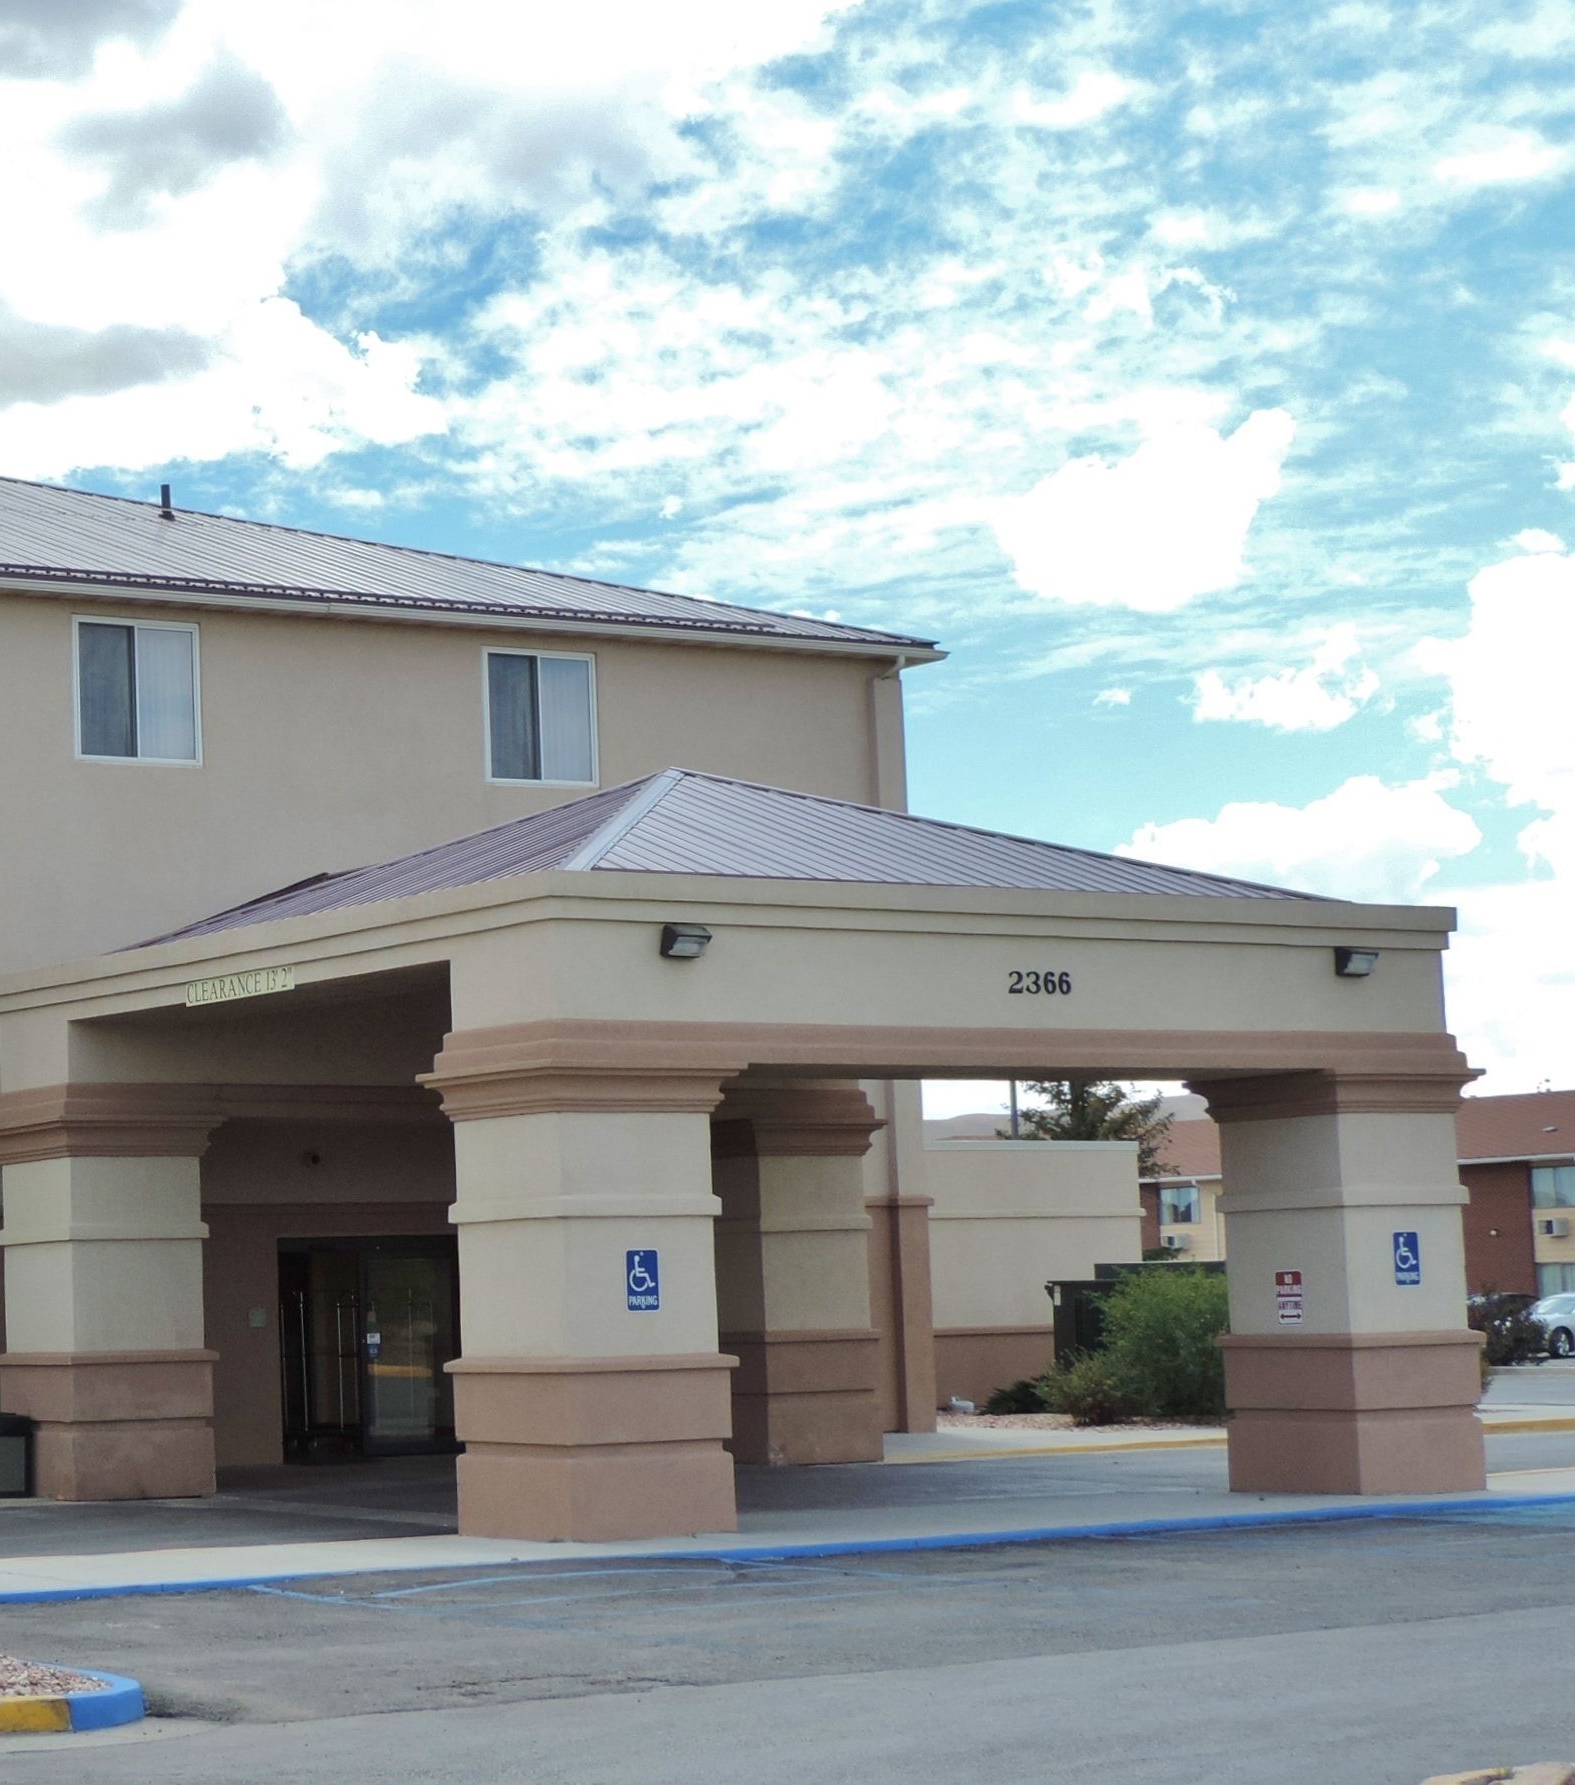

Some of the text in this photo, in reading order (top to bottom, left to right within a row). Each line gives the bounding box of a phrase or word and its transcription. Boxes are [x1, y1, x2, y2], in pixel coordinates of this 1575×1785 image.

[187, 972, 262, 1004] CLEARANCE
[1008, 970, 1072, 995] 2366
[628, 1295, 658, 1306] PARKING
